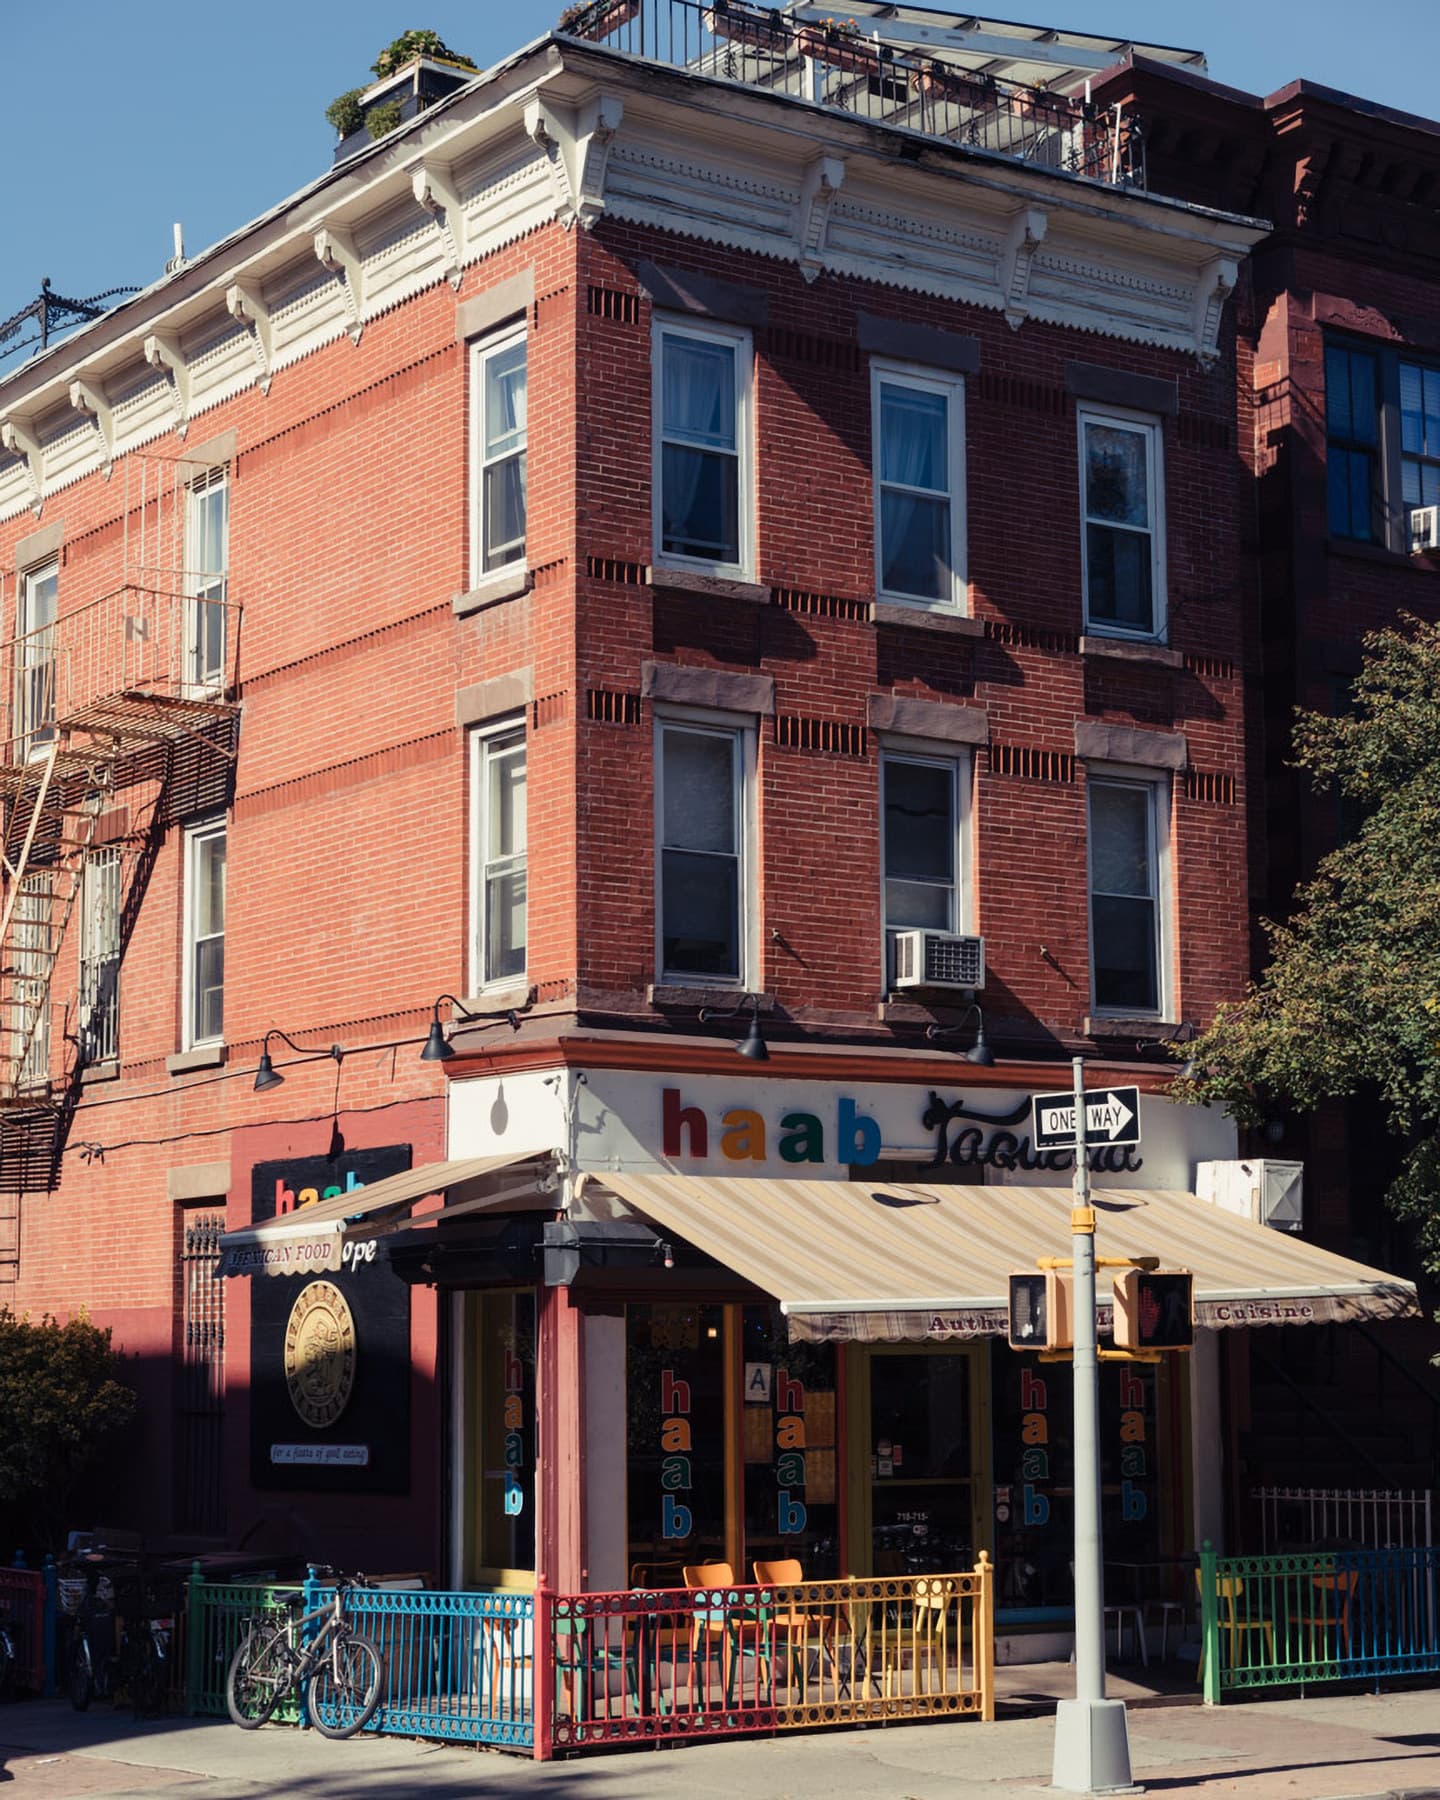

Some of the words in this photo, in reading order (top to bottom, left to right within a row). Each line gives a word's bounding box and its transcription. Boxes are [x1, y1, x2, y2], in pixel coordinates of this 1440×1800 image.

[661, 1088, 882, 1166] haab
[923, 1091, 1143, 1171] Taqueia
[1049, 1110, 1077, 1131] ONE
[1091, 1106, 1123, 1128] WAY
[295, 1242, 331, 1260] FOOD
[927, 1315, 1009, 1332] Authe
[1216, 1303, 1313, 1321] Cuisine
[750, 1368, 766, 1391] A
[504, 1347, 524, 1517] haab
[660, 1368, 692, 1540] haab
[775, 1367, 808, 1535] haab
[1020, 1368, 1051, 1527] haab
[1120, 1368, 1148, 1521] haab
